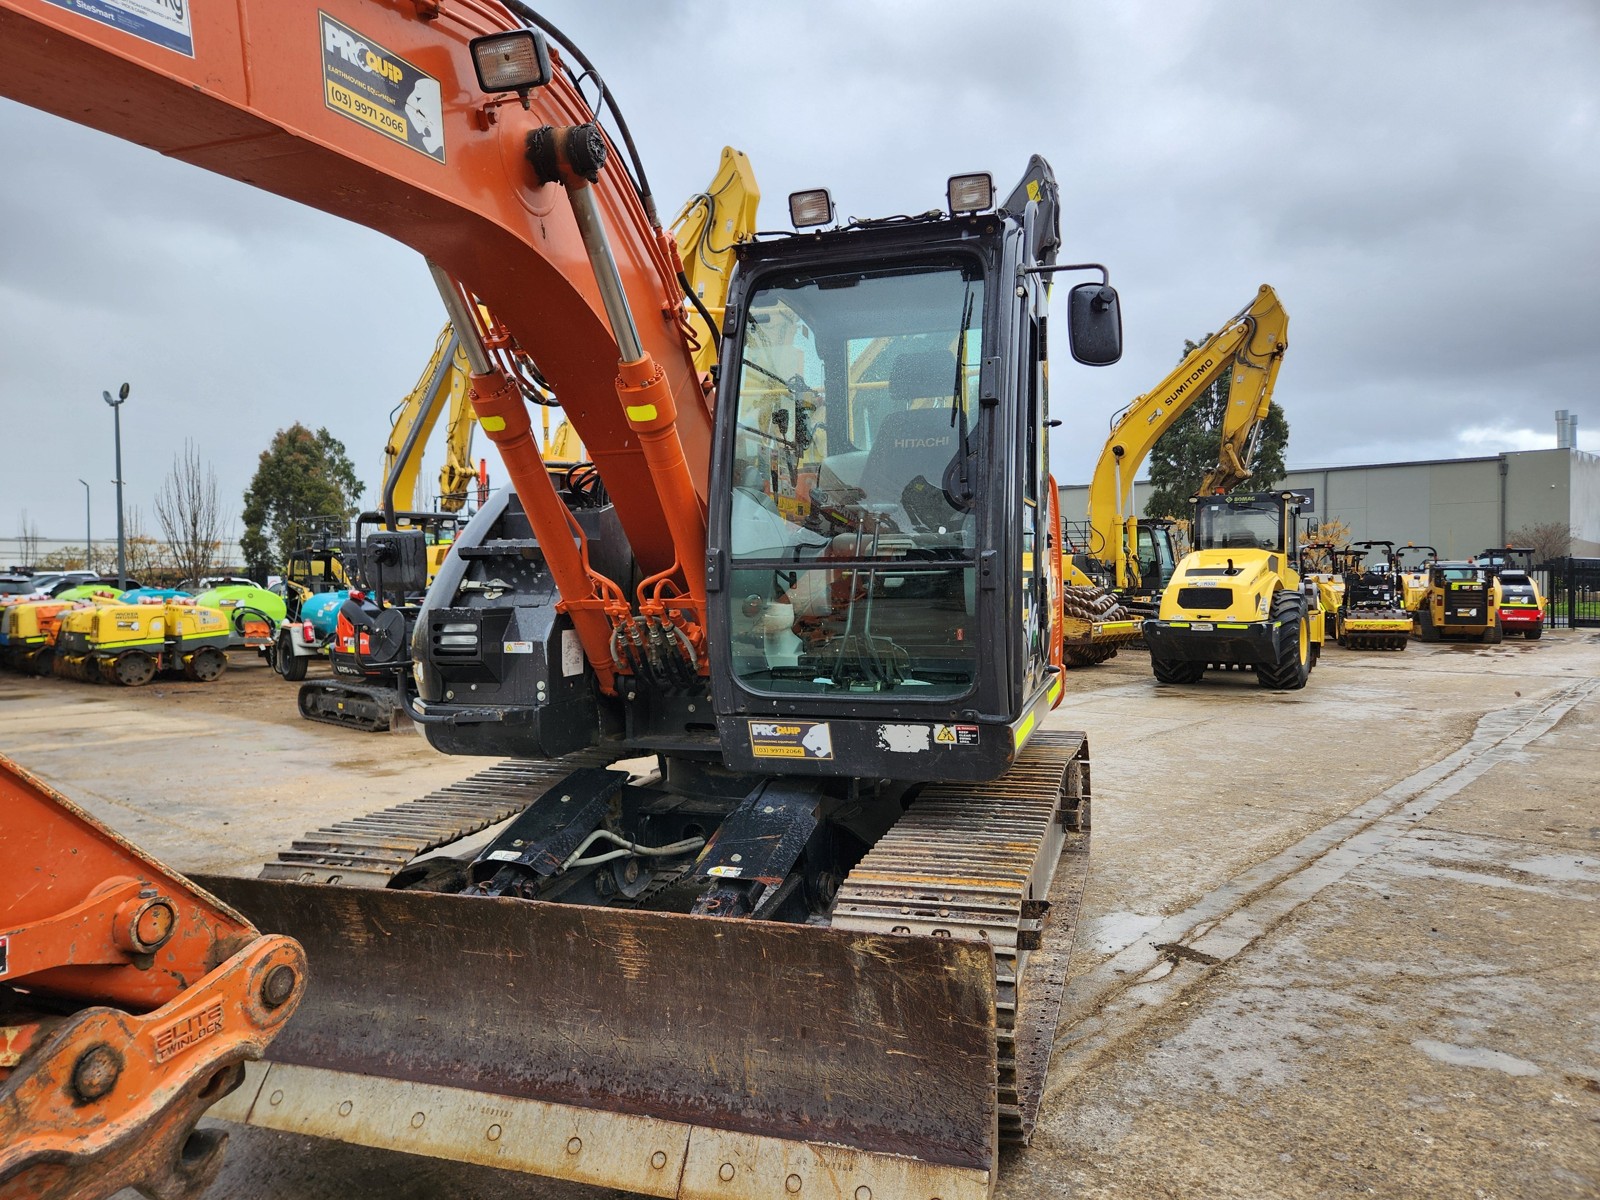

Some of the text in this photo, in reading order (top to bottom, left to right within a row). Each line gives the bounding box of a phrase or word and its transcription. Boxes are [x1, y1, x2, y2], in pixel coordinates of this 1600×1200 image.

[76, 0, 115, 20] SiteSmart
[327, 64, 397, 106] EARTHMOVING EQUIPMENT
[331, 86, 404, 133] (03) 9971 2066
[1165, 359, 1213, 406] SUMITOMO
[894, 436, 950, 448] HITACHI
[156, 1003, 222, 1048] ELITE
[159, 1021, 222, 1059] TWINLOCK
